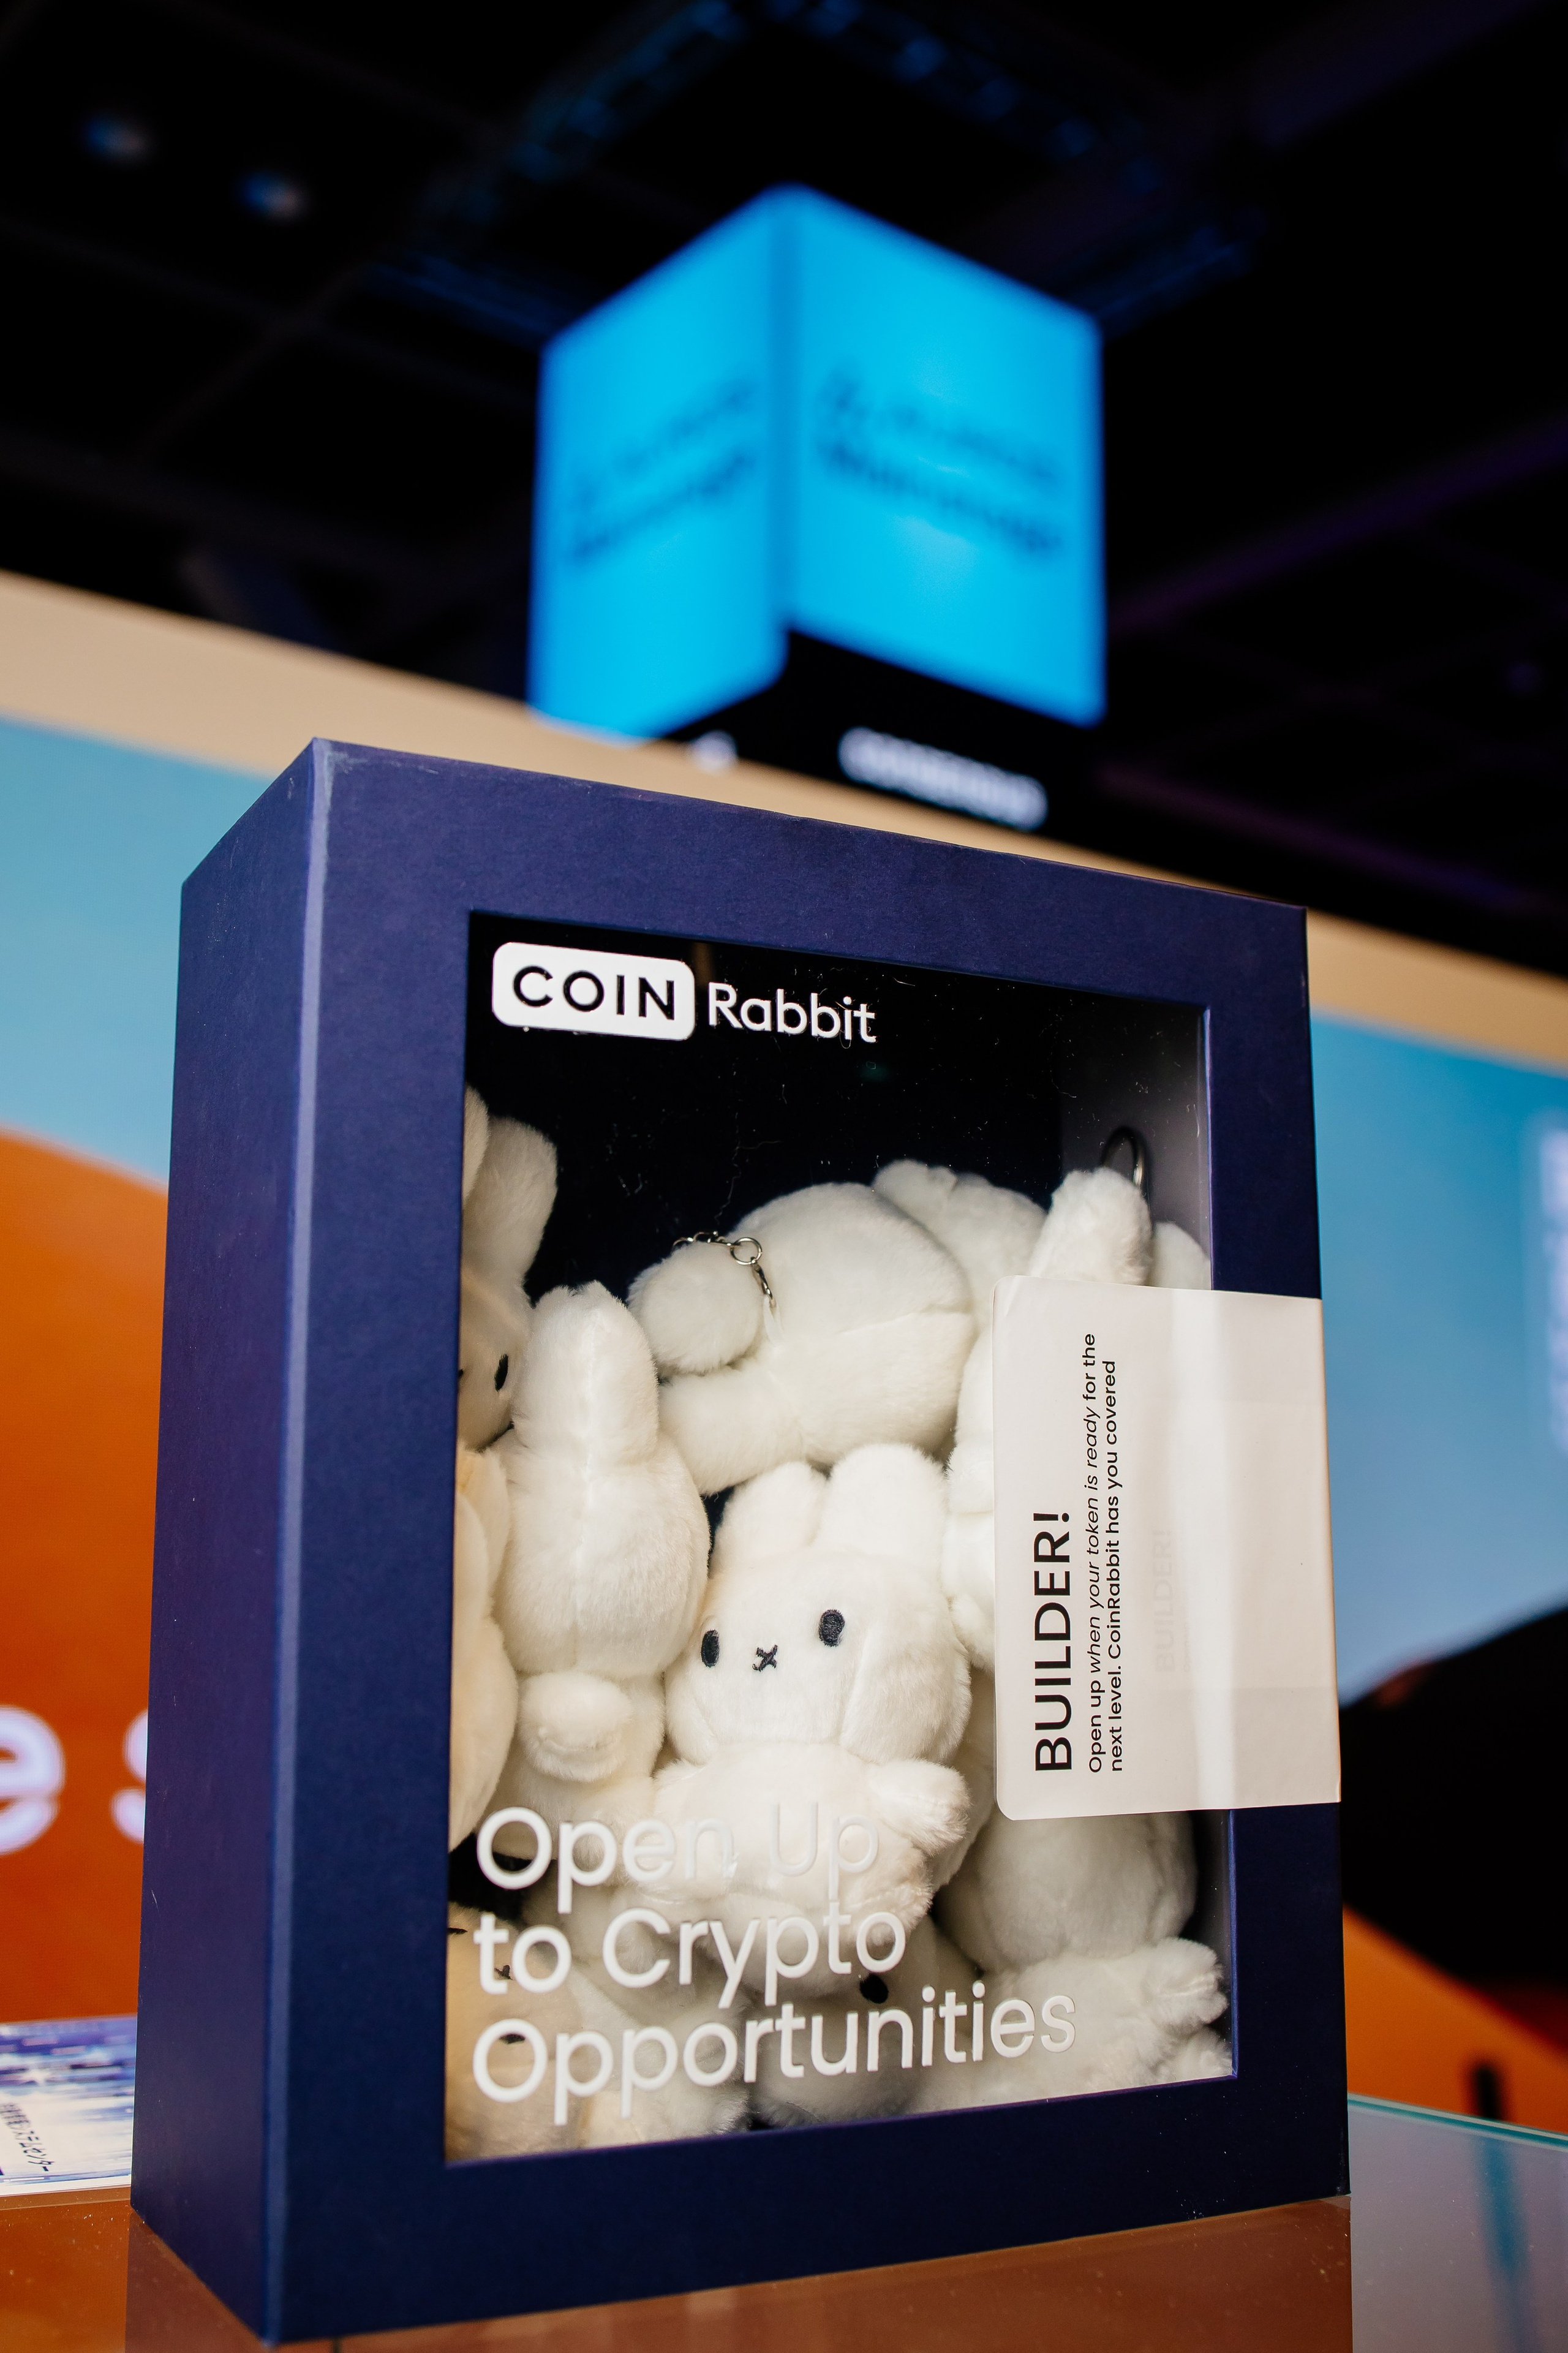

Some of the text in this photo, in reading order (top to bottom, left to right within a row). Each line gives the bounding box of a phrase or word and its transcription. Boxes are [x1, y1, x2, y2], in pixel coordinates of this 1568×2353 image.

[513, 965, 876, 1043] COIN Rabbit
[1082, 1333, 1106, 1773] Open up when your token is ready for the
[1102, 1360, 1123, 1772] next level. CoinRabbit has you covered
[1033, 1513, 1072, 1771] BUILDER!
[477, 1802, 880, 1914] Open Up
[473, 1900, 906, 2009] to Crypto
[472, 1981, 1076, 2126] Opportunities
